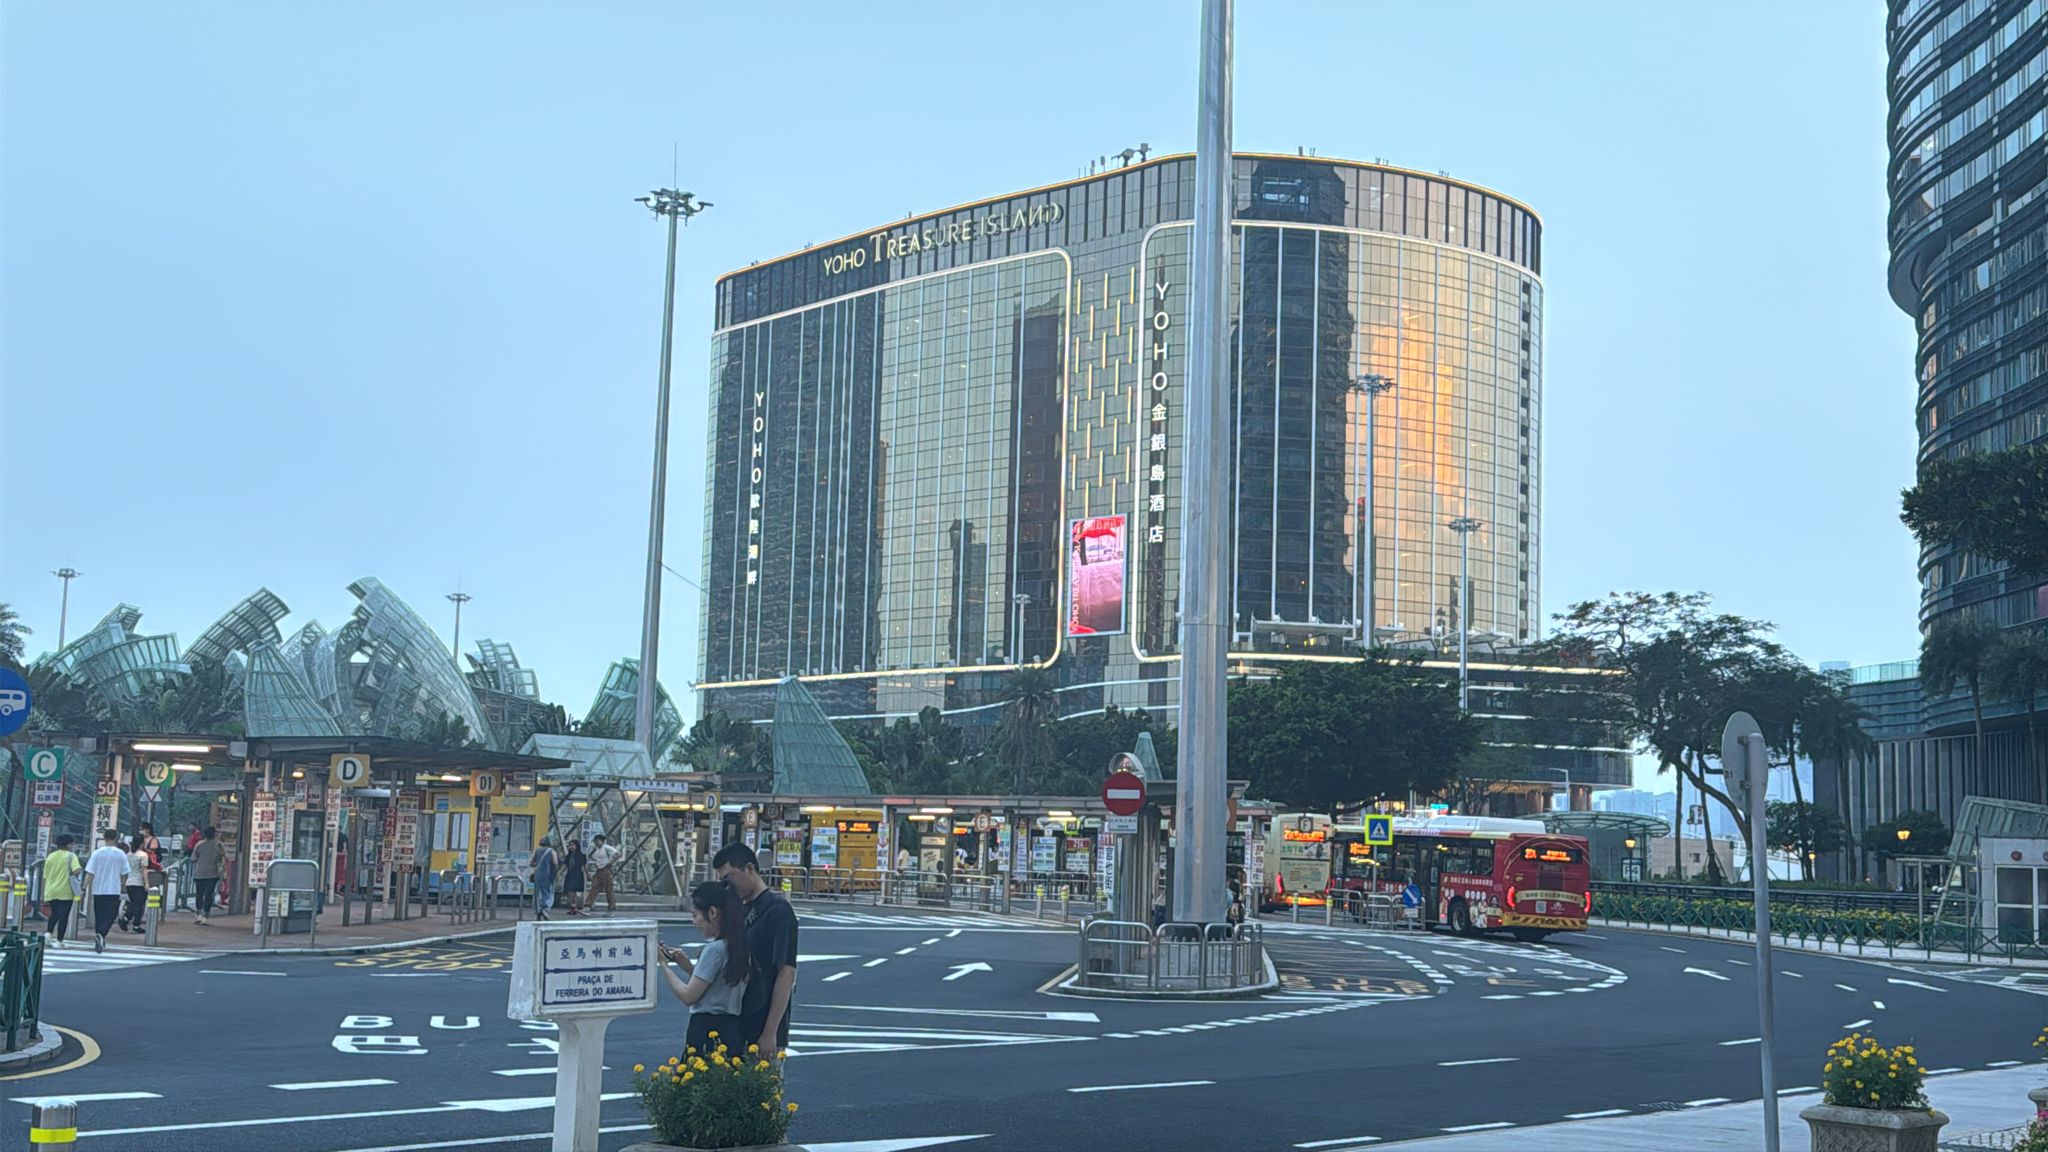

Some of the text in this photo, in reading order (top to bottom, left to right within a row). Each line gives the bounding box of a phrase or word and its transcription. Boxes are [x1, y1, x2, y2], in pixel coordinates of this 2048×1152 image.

[823, 201, 1062, 277] YOHO TREASURE ISLAND
[37, 753, 52, 774] C
[342, 760, 357, 781] D
[149, 764, 165, 780] C2
[97, 781, 116, 795] 50
[479, 777, 493, 791] D1
[577, 974, 614, 985] PRAÇA DE
[555, 985, 634, 998] FERREIRA DO AMARAL
